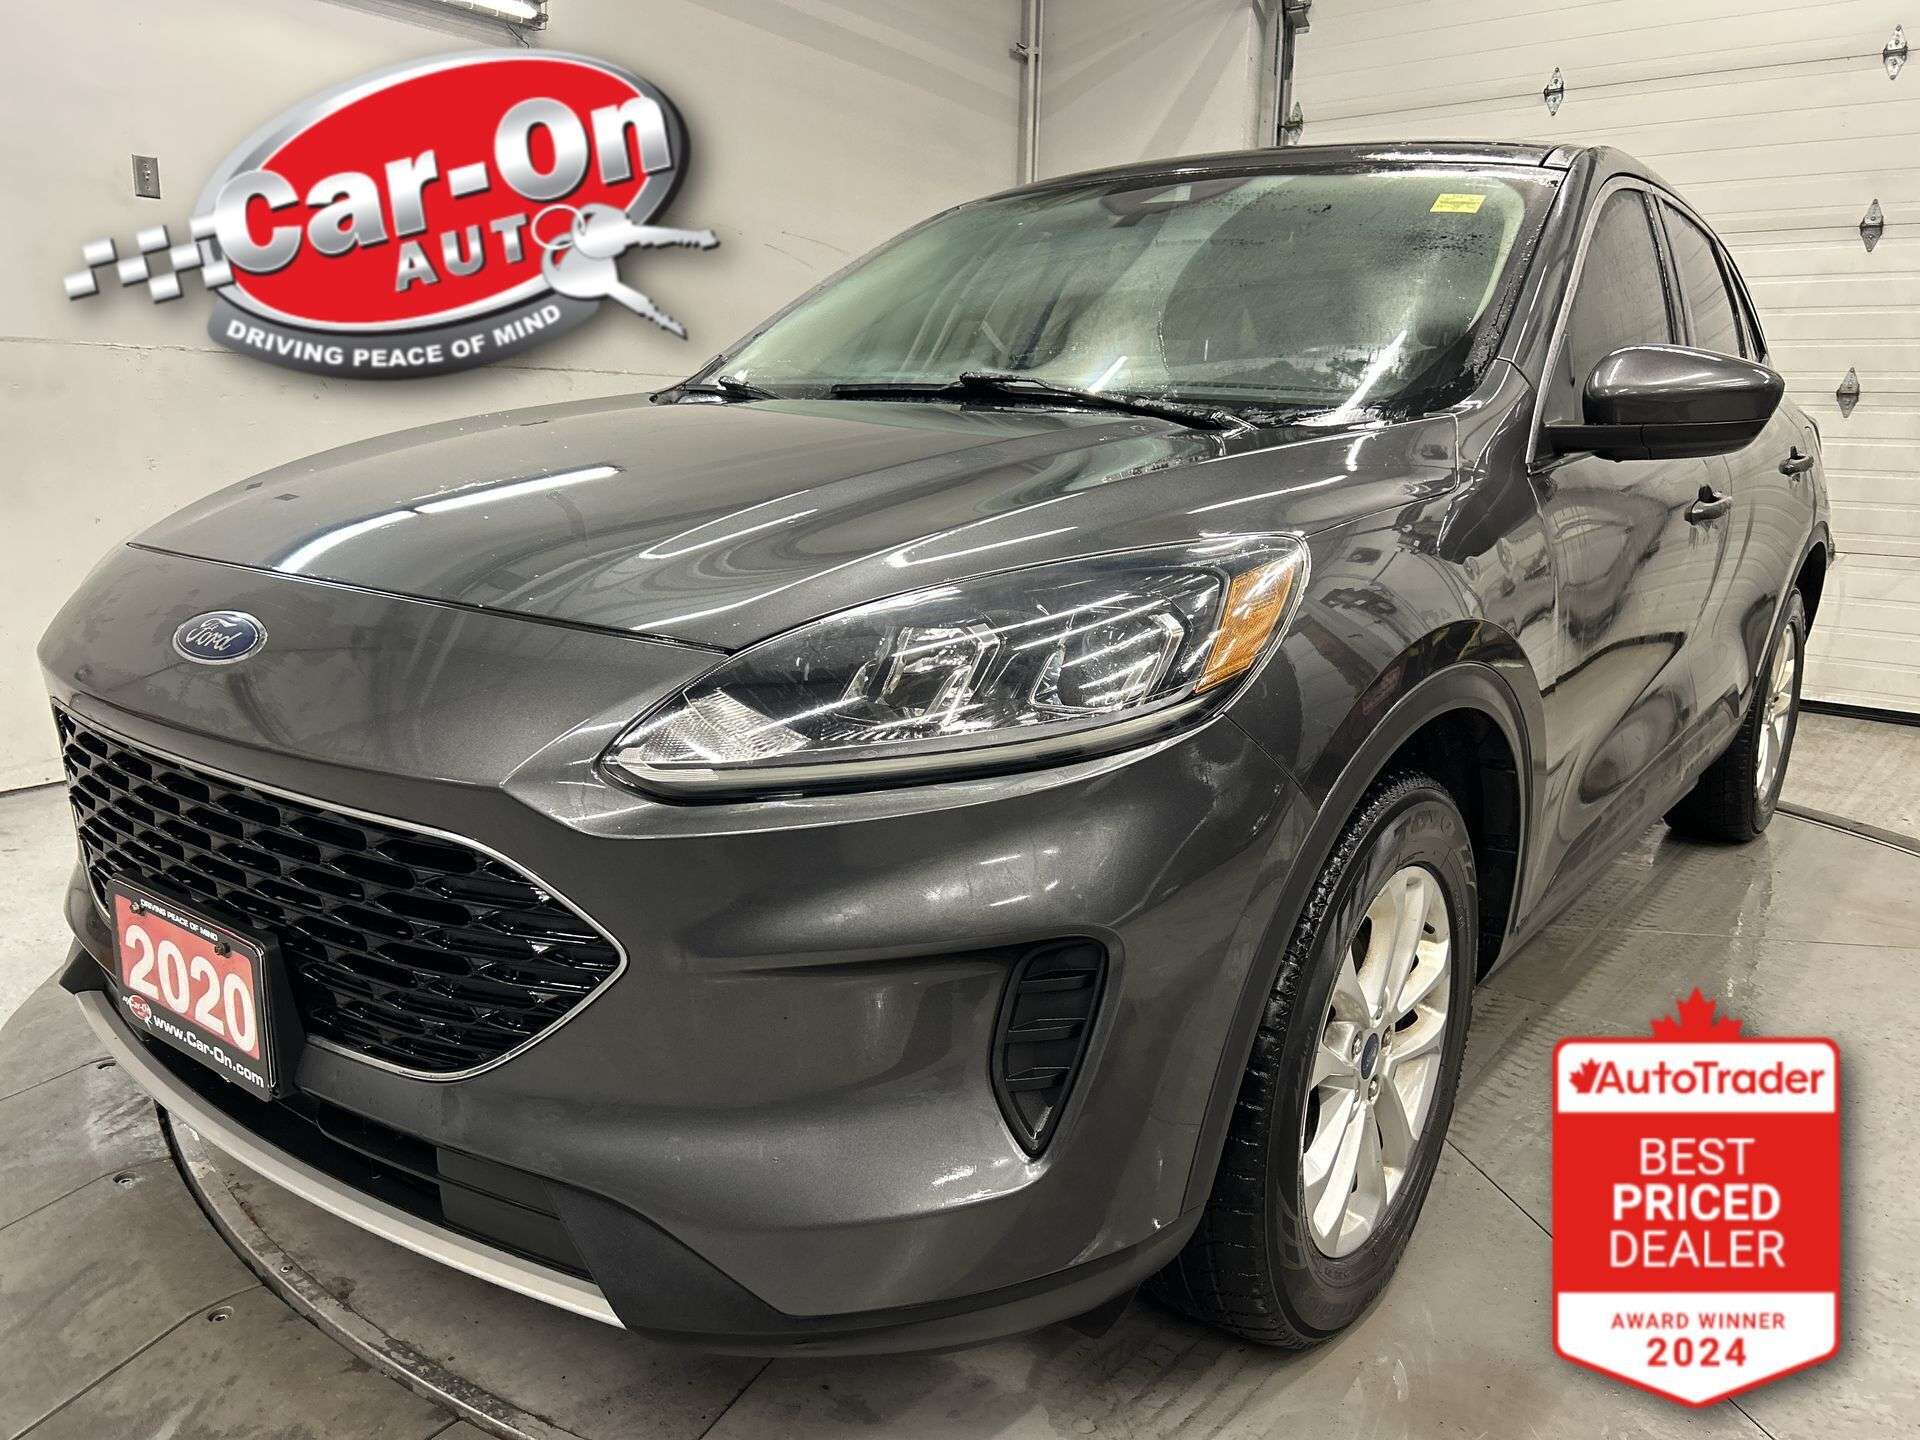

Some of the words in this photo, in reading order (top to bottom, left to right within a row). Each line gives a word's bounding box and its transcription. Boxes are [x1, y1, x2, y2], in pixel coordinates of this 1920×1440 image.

[185, 618, 243, 651] Ford
[125, 924, 257, 1052] 2020
[153, 1014, 264, 1088] www.Car-On.com
